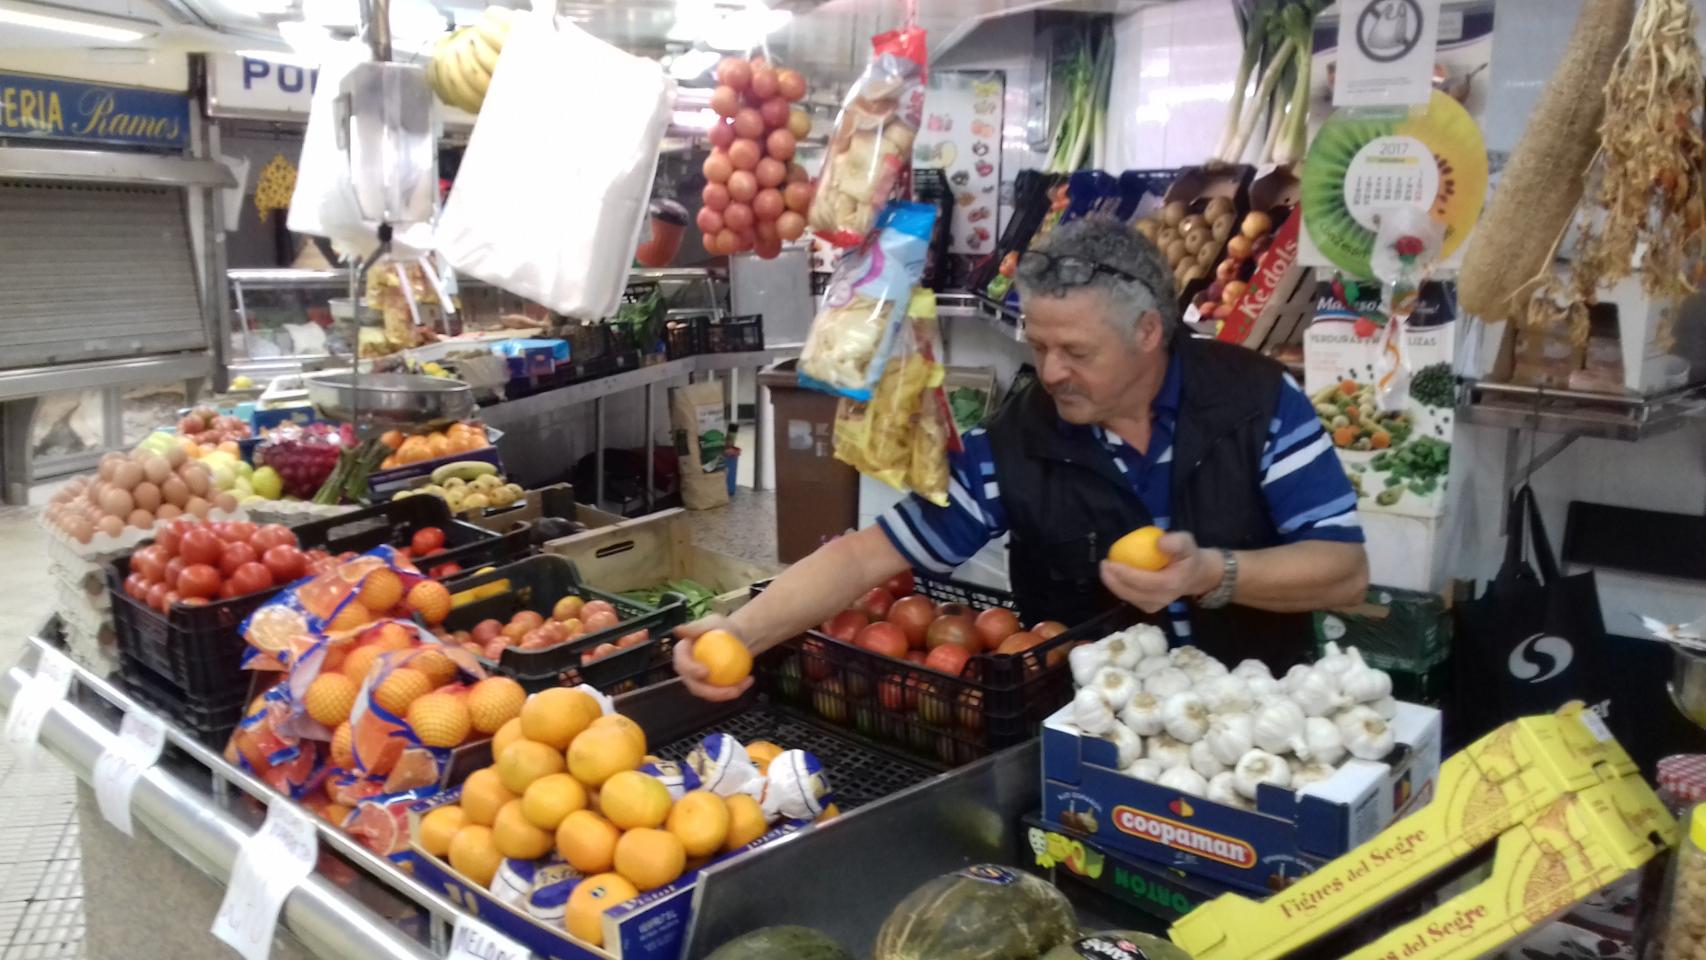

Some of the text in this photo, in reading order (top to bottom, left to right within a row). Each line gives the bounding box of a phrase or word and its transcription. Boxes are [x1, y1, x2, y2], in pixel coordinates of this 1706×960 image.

[0, 87, 180, 140] ERIA Ramos
[1379, 142, 1409, 155] 2017
[1121, 811, 1246, 862] coopaman
[1280, 876, 1344, 919] Figues
[1347, 860, 1370, 882] del
[1370, 829, 1428, 868] Segre
[1402, 904, 1485, 957] del Segre
